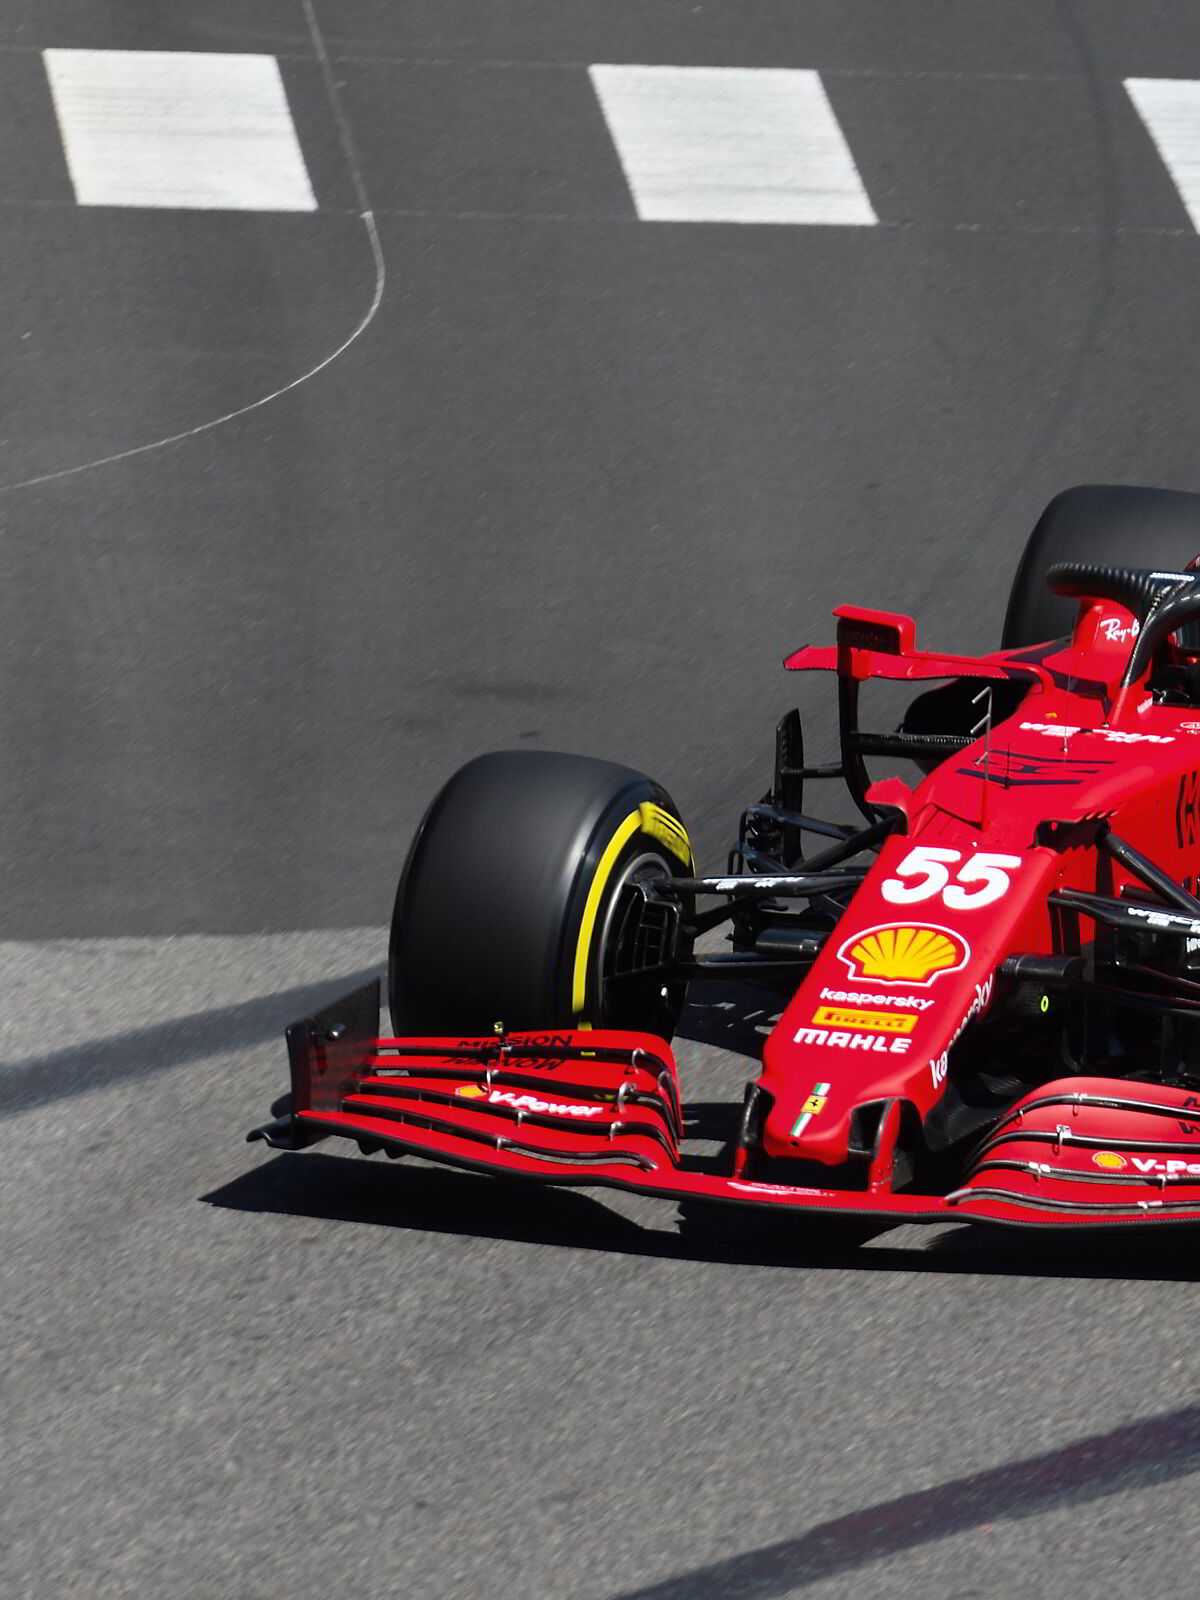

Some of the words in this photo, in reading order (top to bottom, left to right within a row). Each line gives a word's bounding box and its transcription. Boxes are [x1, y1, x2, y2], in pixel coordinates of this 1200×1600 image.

[1099, 617, 1141, 644] Ray-B
[881, 846, 1022, 911] 55
[819, 987, 936, 1011] kaspersky
[792, 1027, 913, 1054] MAHLE
[488, 1089, 604, 1118] V-Power
